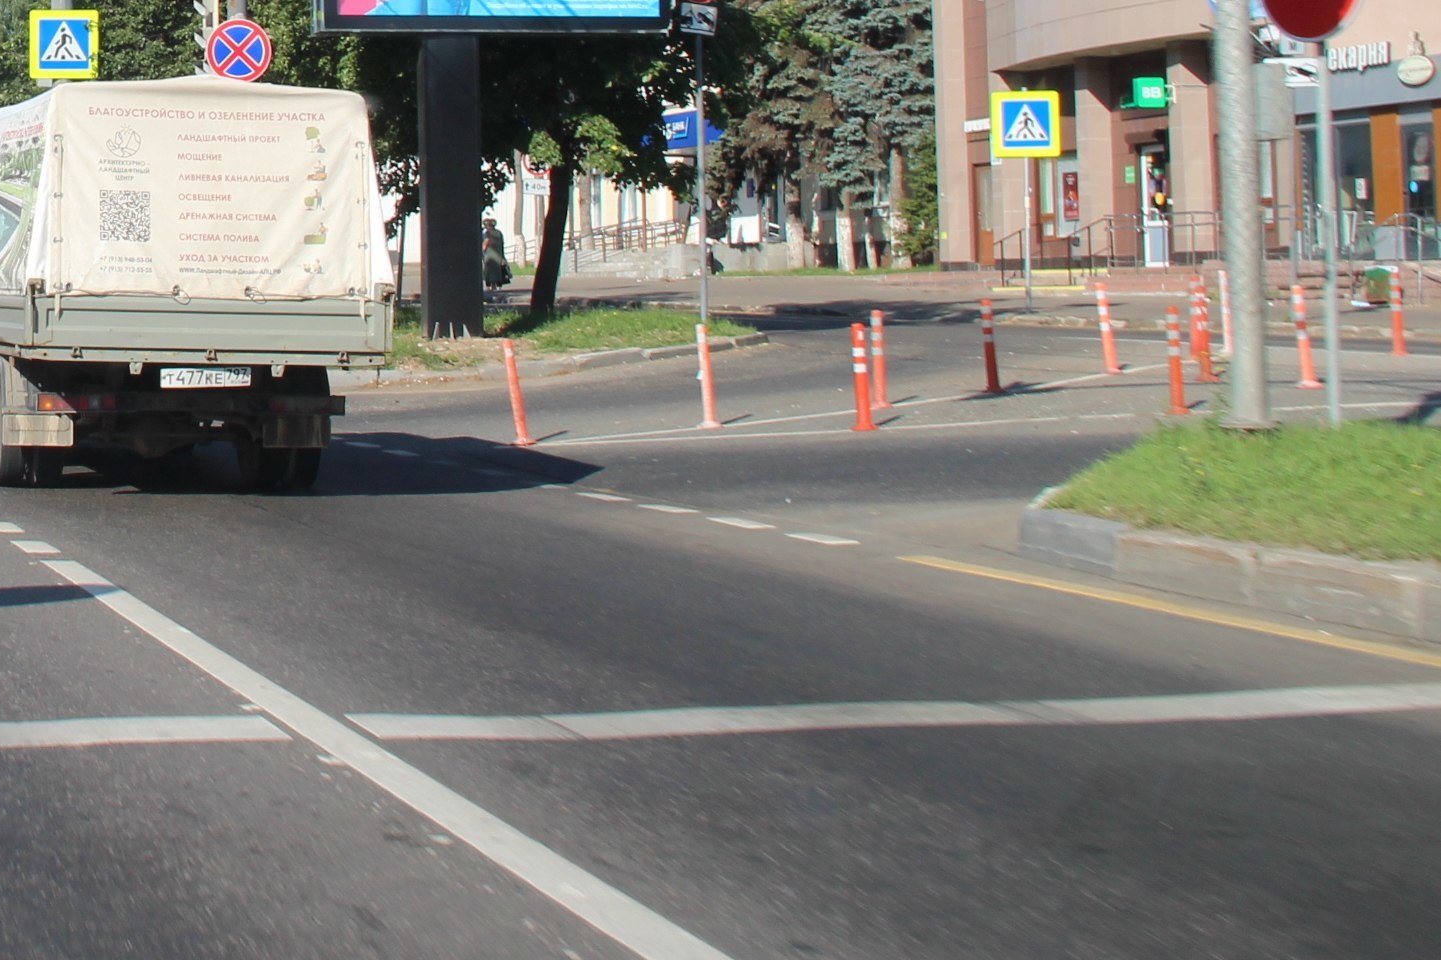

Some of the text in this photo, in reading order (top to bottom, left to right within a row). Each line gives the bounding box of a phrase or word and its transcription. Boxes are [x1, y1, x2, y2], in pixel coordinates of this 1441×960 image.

[1327, 42, 1389, 72] екарня
[88, 106, 326, 122] БЛАГОУСТРОЙСТВО И ОЗЕЛЕНЕНИЕ УЧАСТКА
[177, 133, 280, 143] ЛАНДШАФТНЫЙ ПРОЕКТ
[177, 152, 222, 161] МОЩЕНИЕ
[178, 173, 290, 183] ЛИВНЕВАЯ КАНАЛИЗАЦИЯ
[178, 193, 232, 201] ОСВЕЩЕНИЕ
[178, 212, 277, 221] ДРЕНАЖНАЯ СИСТЕМА
[179, 233, 260, 242] СИСТЕМА ПОЛИВА
[179, 254, 269, 263] УХОД ЗА УЧАСТКОМ
[166, 368, 248, 385] Т477КЕ 797
